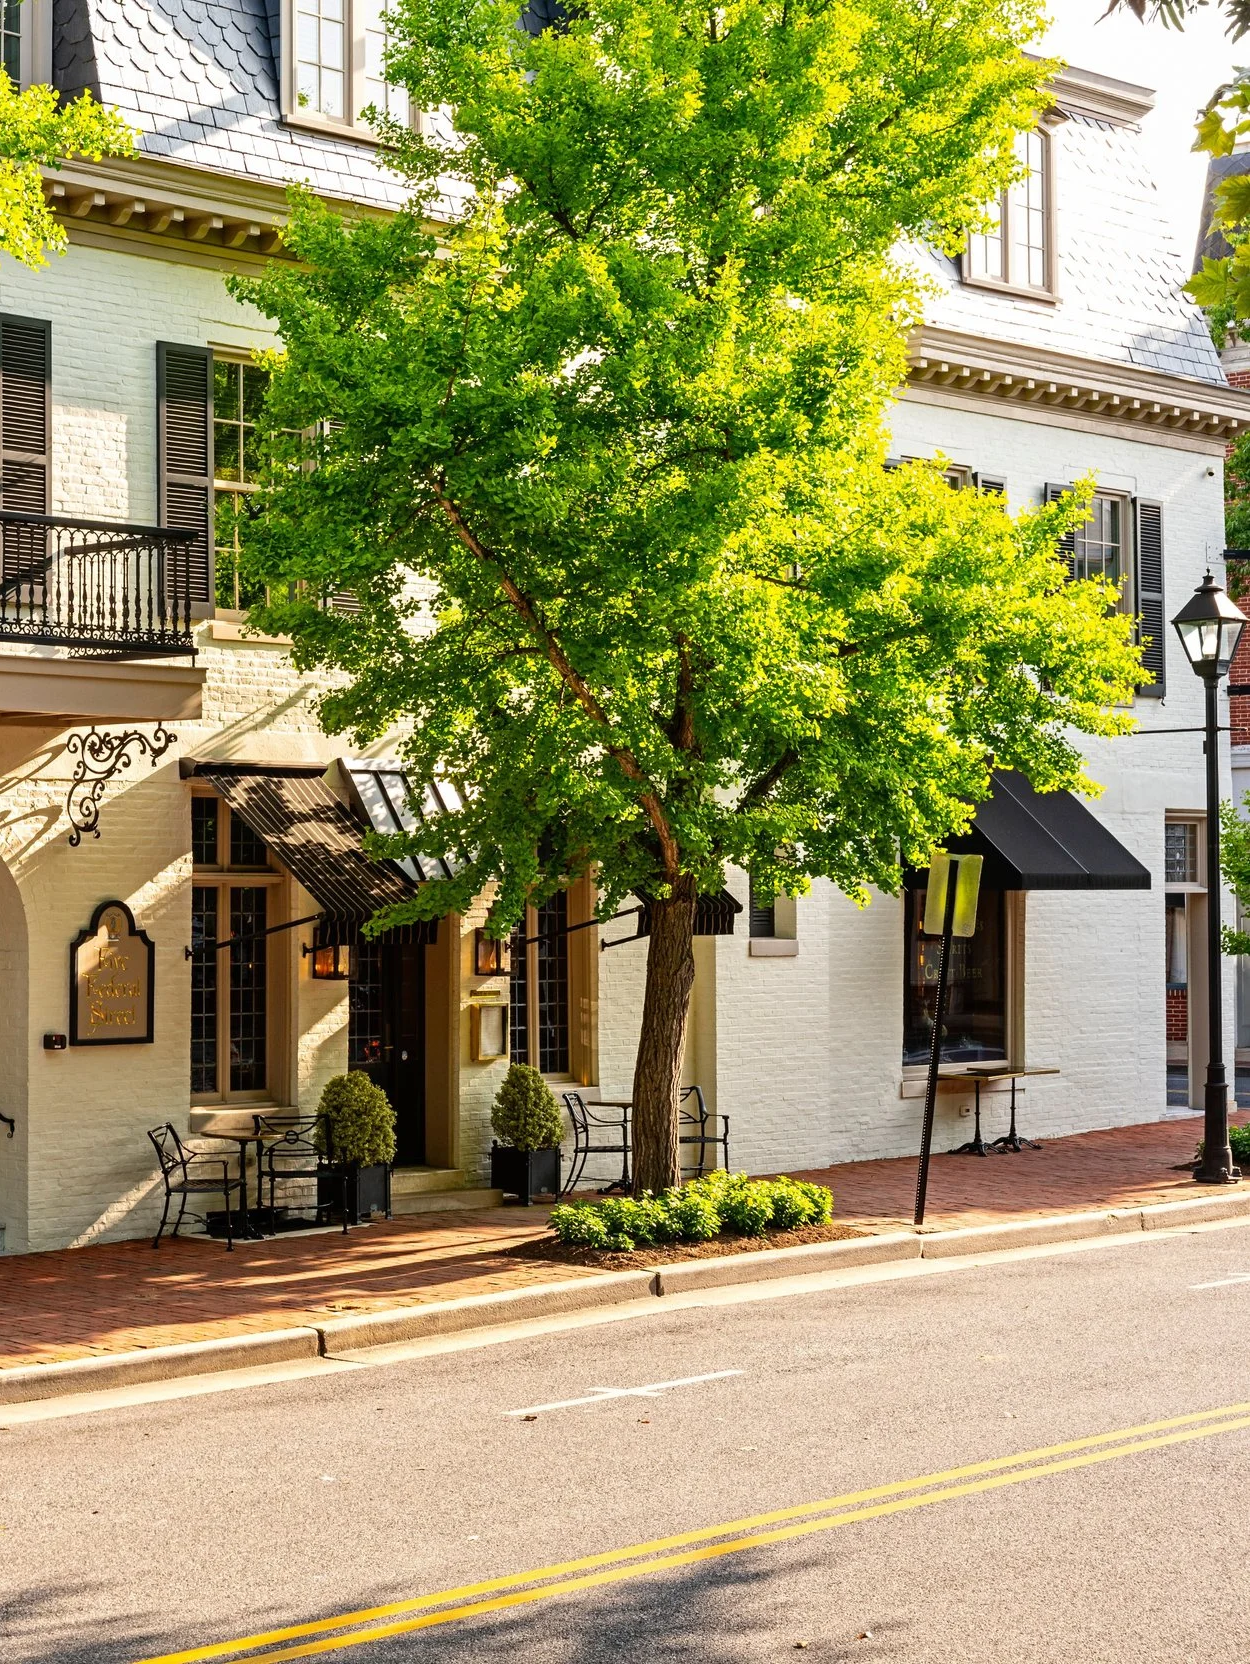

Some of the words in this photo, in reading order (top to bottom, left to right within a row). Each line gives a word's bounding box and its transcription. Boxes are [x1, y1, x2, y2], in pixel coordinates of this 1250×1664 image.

[94, 946, 129, 972] Five
[82, 973, 140, 998] Federal
[87, 1000, 136, 1036] Street
